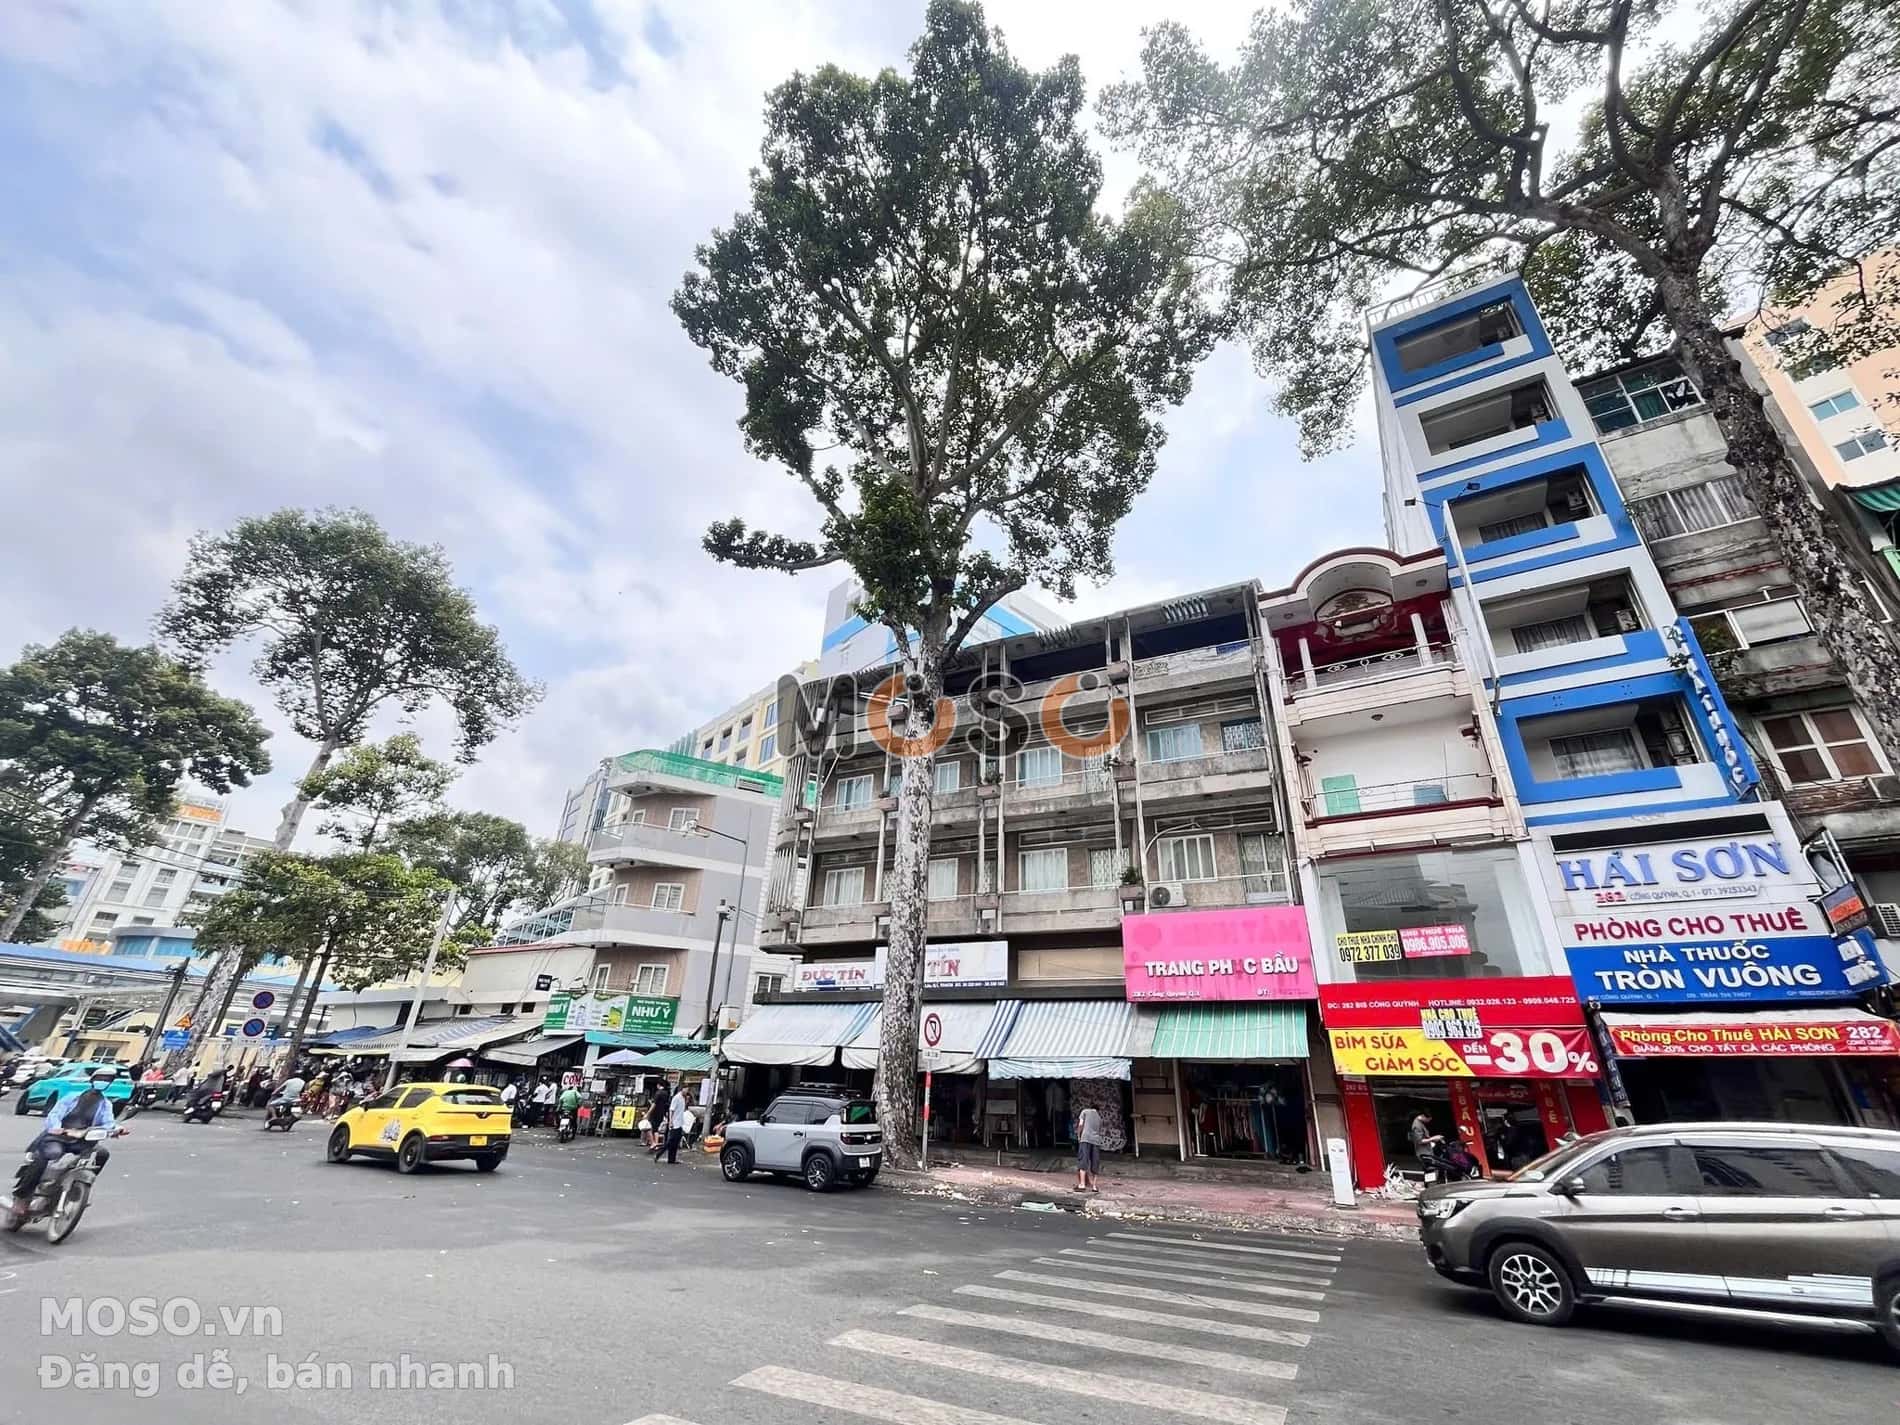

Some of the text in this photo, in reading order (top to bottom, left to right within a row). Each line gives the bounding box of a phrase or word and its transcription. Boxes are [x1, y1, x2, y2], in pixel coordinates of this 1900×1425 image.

[1557, 841, 1790, 891] HẢI SƠN
[1574, 915, 1662, 941] PHÒNG
[1668, 916, 1724, 937] CHO
[1729, 906, 1808, 933] THUÊ
[1339, 945, 1363, 962] 0972
[1363, 944, 1380, 960] 377
[1382, 943, 1401, 959] 039
[1623, 939, 1771, 965] NHÀ THUỐC
[836, 966, 866, 980] TÍN
[1145, 951, 1299, 977] TRANG PHC BẦU
[1595, 961, 1822, 991] TRÒN VUÔNG
[631, 1005, 661, 1018] NHƯ
[1368, 1000, 1391, 1008] CÔNG
[1428, 999, 1465, 1007] HOTLINE:
[1372, 1031, 1408, 1050] SỮA
[1620, 1024, 1840, 1045] Phòng Cho Thuê HẢI SƠN
[1846, 1025, 1883, 1039] 282
[1463, 1040, 1488, 1055] ĐẾN
[1687, 1043, 1713, 1053] CHO
[1717, 1041, 1737, 1052] TẤT
[1761, 1041, 1787, 1052] CÁC
[1790, 1041, 1836, 1052] PHÒNG
[1366, 1052, 1461, 1072] GIẢM SỐC
